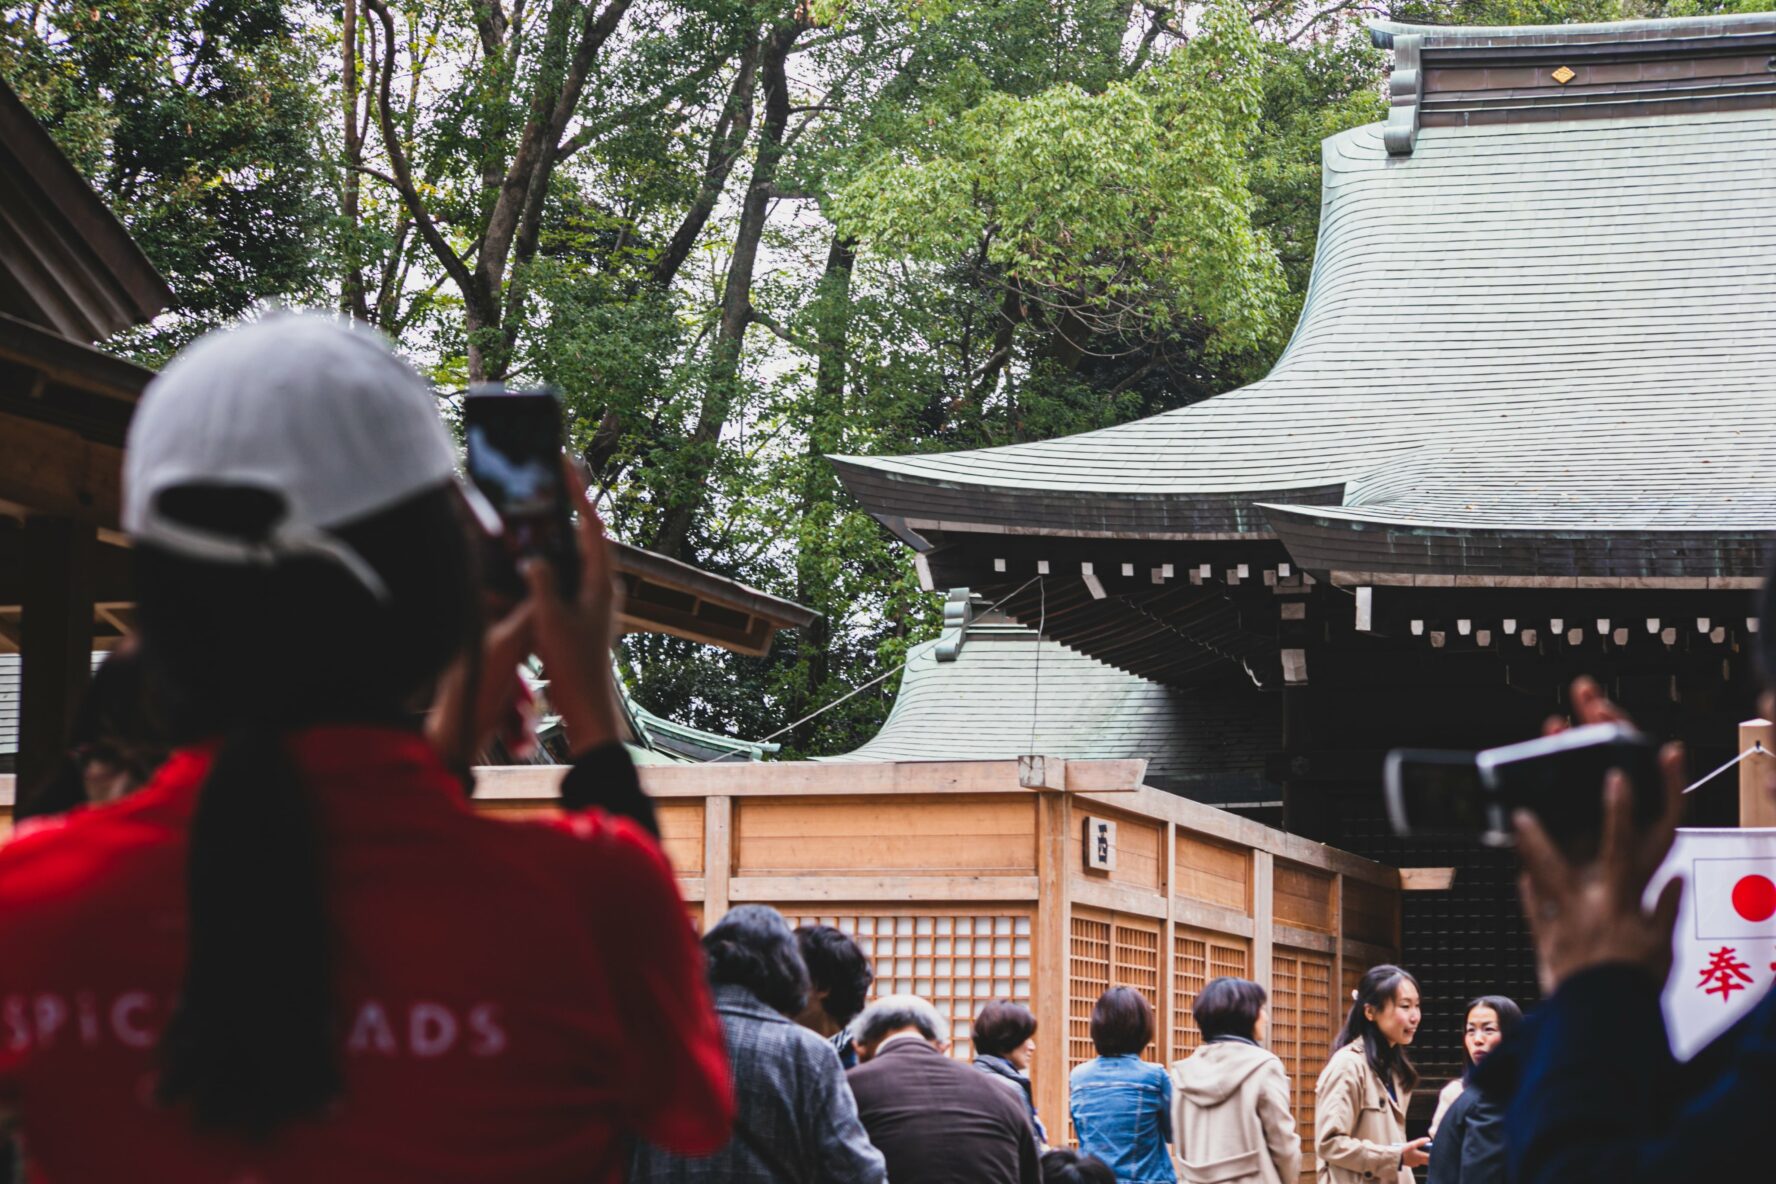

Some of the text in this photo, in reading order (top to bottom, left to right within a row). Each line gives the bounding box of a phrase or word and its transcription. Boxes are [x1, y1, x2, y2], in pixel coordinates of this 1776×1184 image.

[1696, 946, 1776, 1004] 奉
[1, 991, 508, 1056] SPIC ADS
